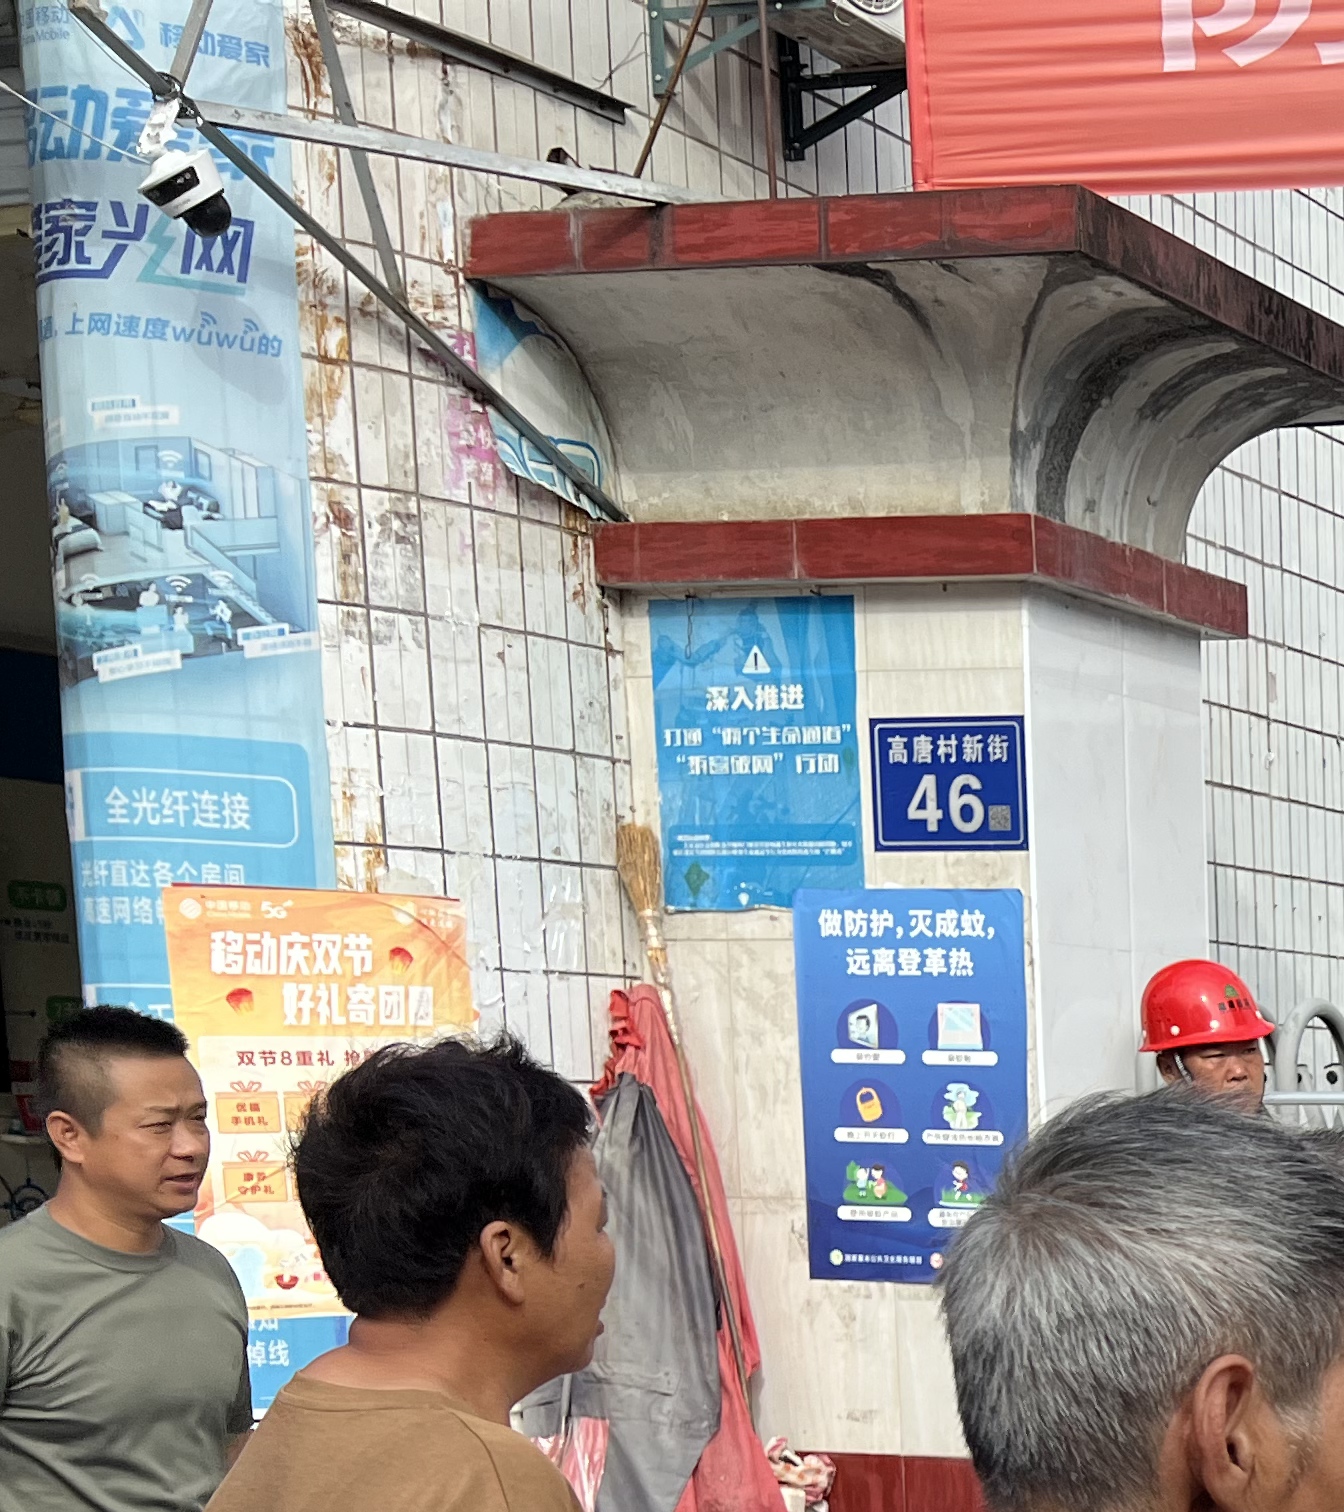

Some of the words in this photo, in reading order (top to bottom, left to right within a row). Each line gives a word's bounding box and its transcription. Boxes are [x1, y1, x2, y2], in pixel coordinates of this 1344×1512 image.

[706, 684, 805, 712] 深入推进
[795, 753, 839, 774] 行动
[887, 734, 1009, 764] 高唐村新街
[105, 785, 251, 830] 全光纤连接
[907, 774, 984, 833] 46
[210, 930, 373, 976] 移动庆双节
[846, 947, 974, 977] 远离登革热
[282, 982, 434, 1026] 好礼寄团圆
[237, 1050, 334, 1067] 双节8重礼
